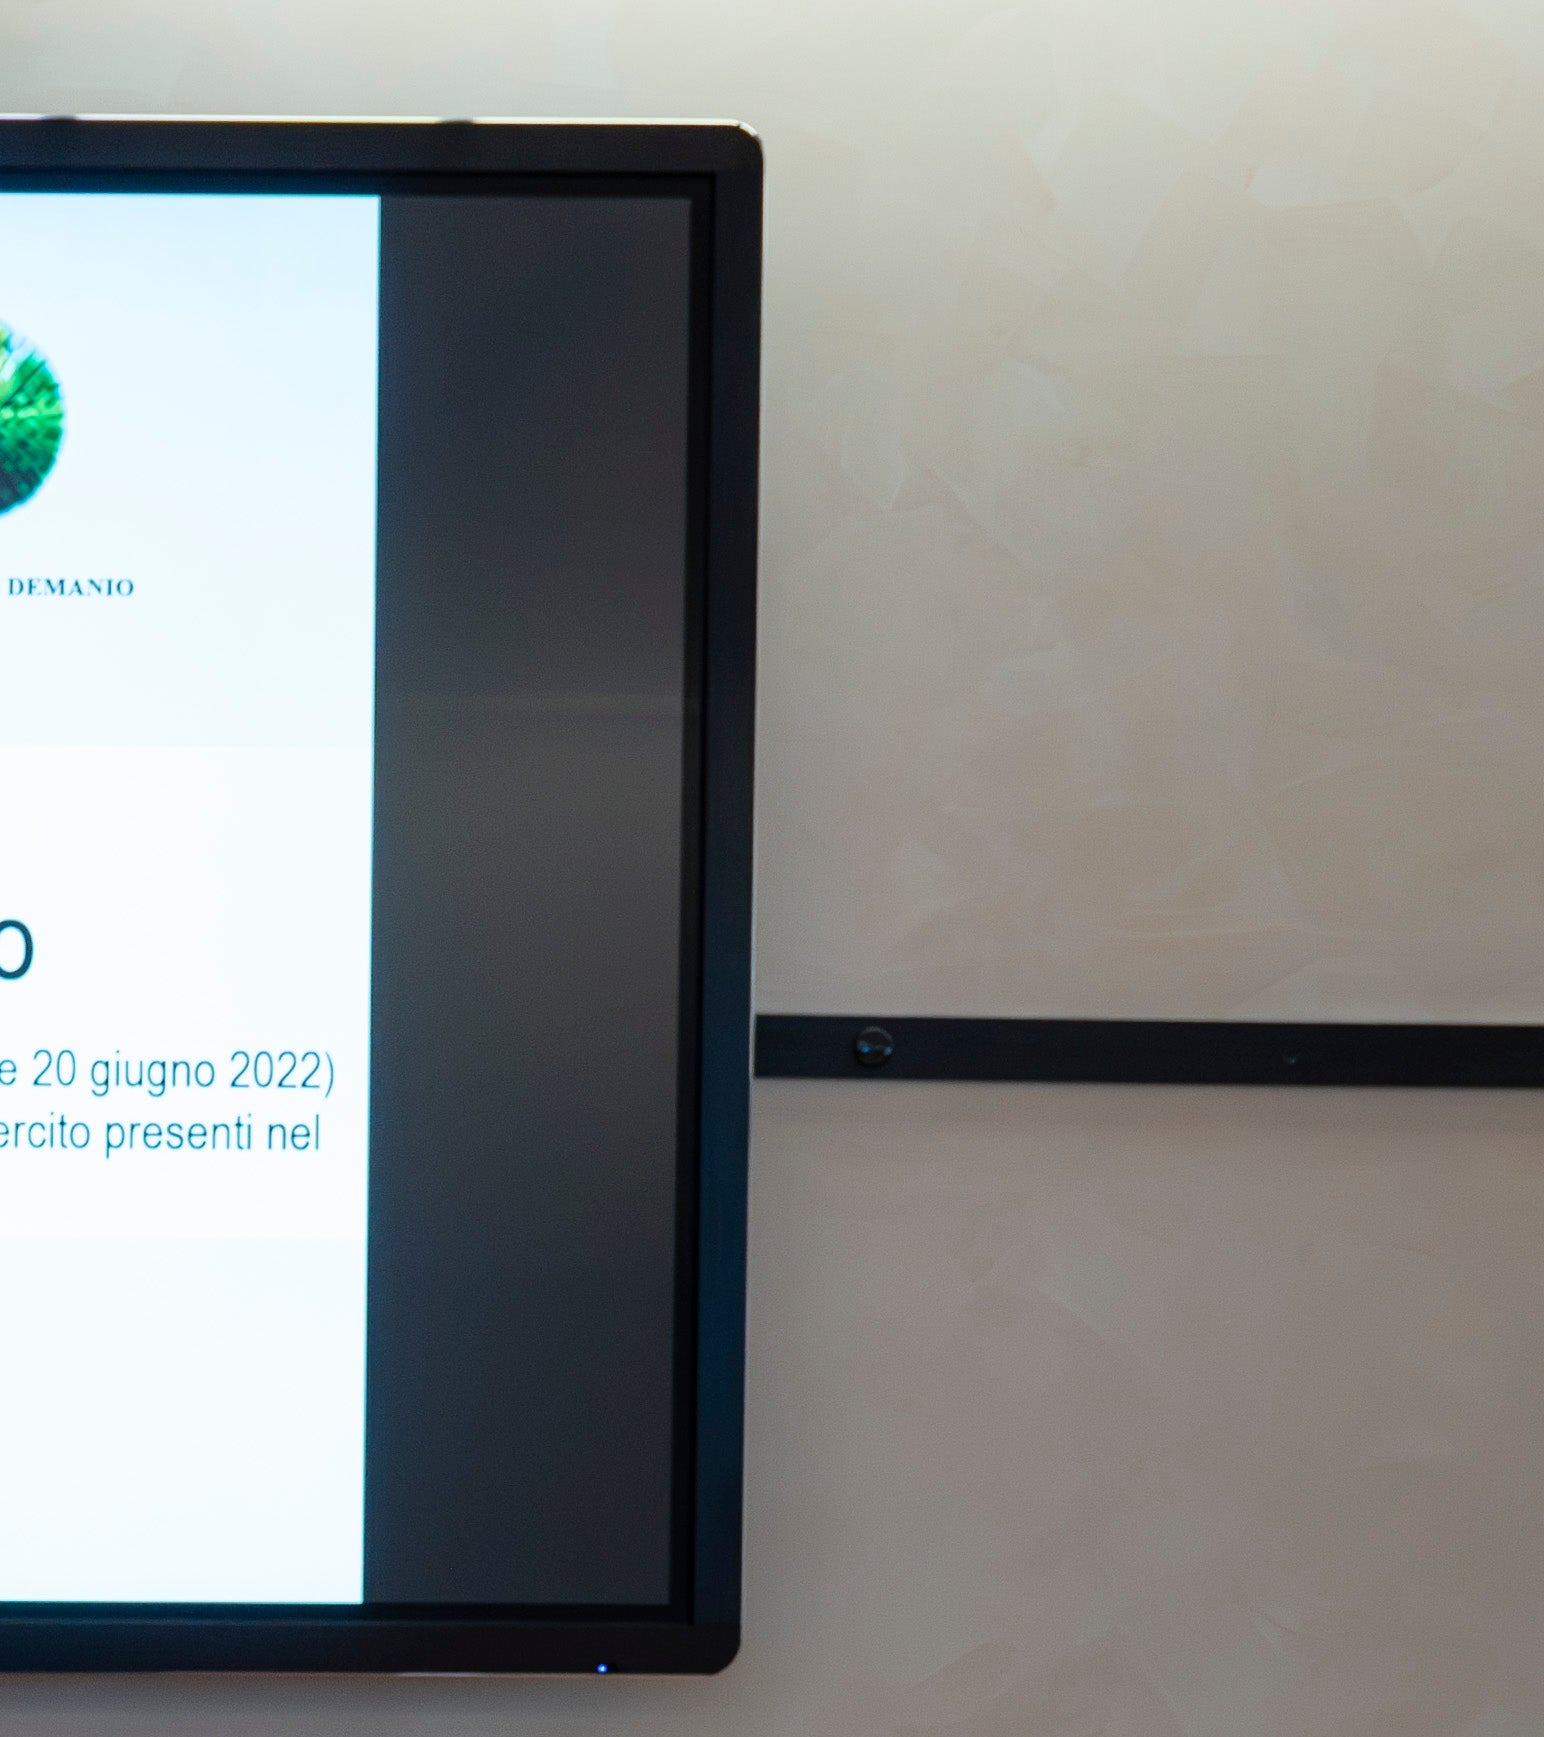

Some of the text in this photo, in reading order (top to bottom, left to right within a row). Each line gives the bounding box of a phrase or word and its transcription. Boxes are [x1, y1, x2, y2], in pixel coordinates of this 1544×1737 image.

[7, 576, 136, 598] DEMANIO
[31, 1047, 78, 1088] 20
[89, 1048, 217, 1099] giugno
[228, 1048, 336, 1100] 2022)
[105, 1112, 253, 1159] presenti
[266, 1113, 321, 1152] nel
